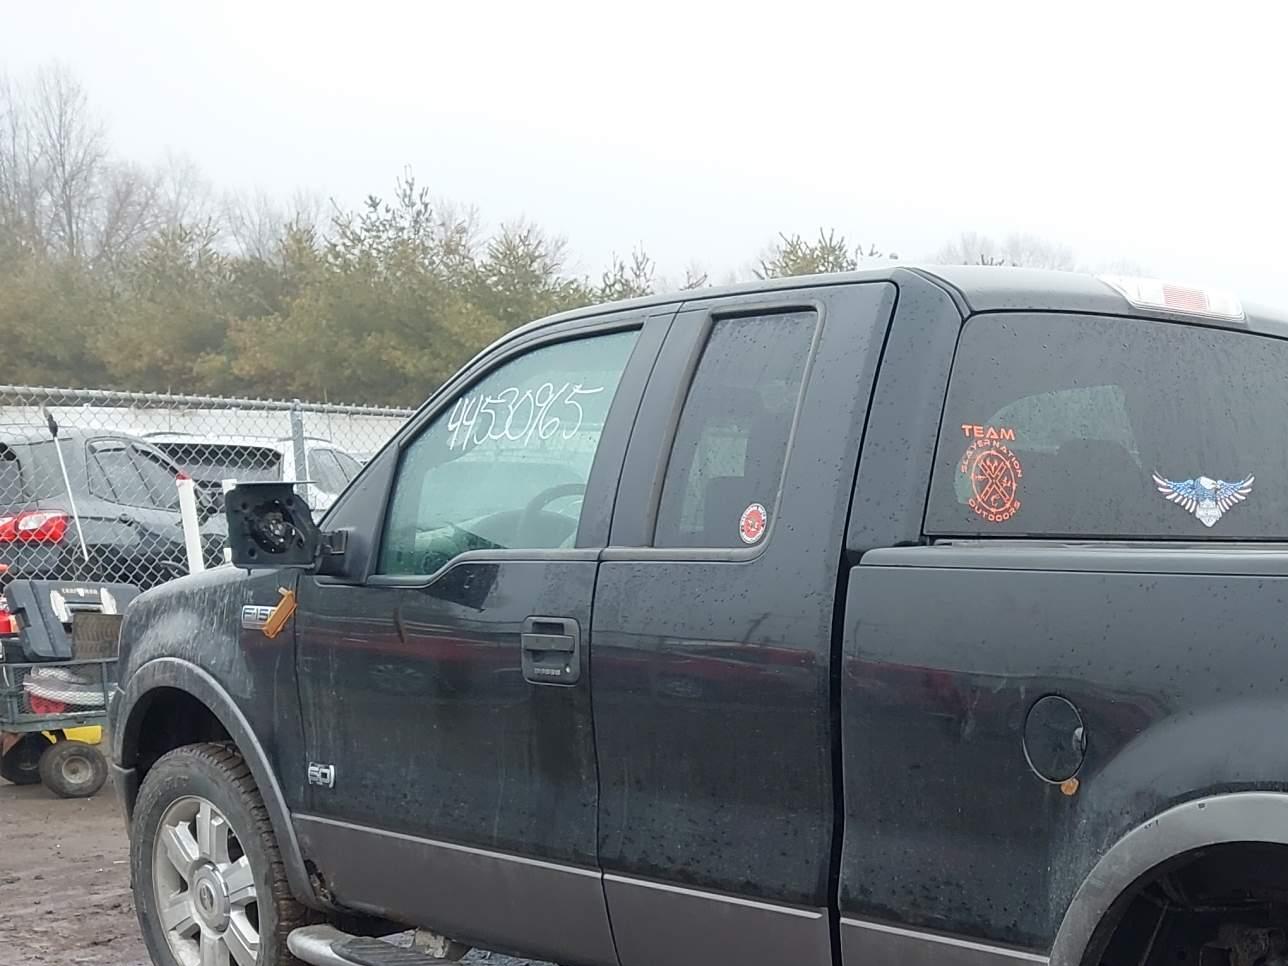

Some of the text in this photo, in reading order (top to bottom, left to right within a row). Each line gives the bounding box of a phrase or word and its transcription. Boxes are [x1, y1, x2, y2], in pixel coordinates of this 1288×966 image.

[448, 382, 604, 450] 44530965
[961, 424, 1015, 440] TEAM
[961, 440, 1022, 478] SLAYER NATION
[968, 498, 1021, 522] OUTDOORS
